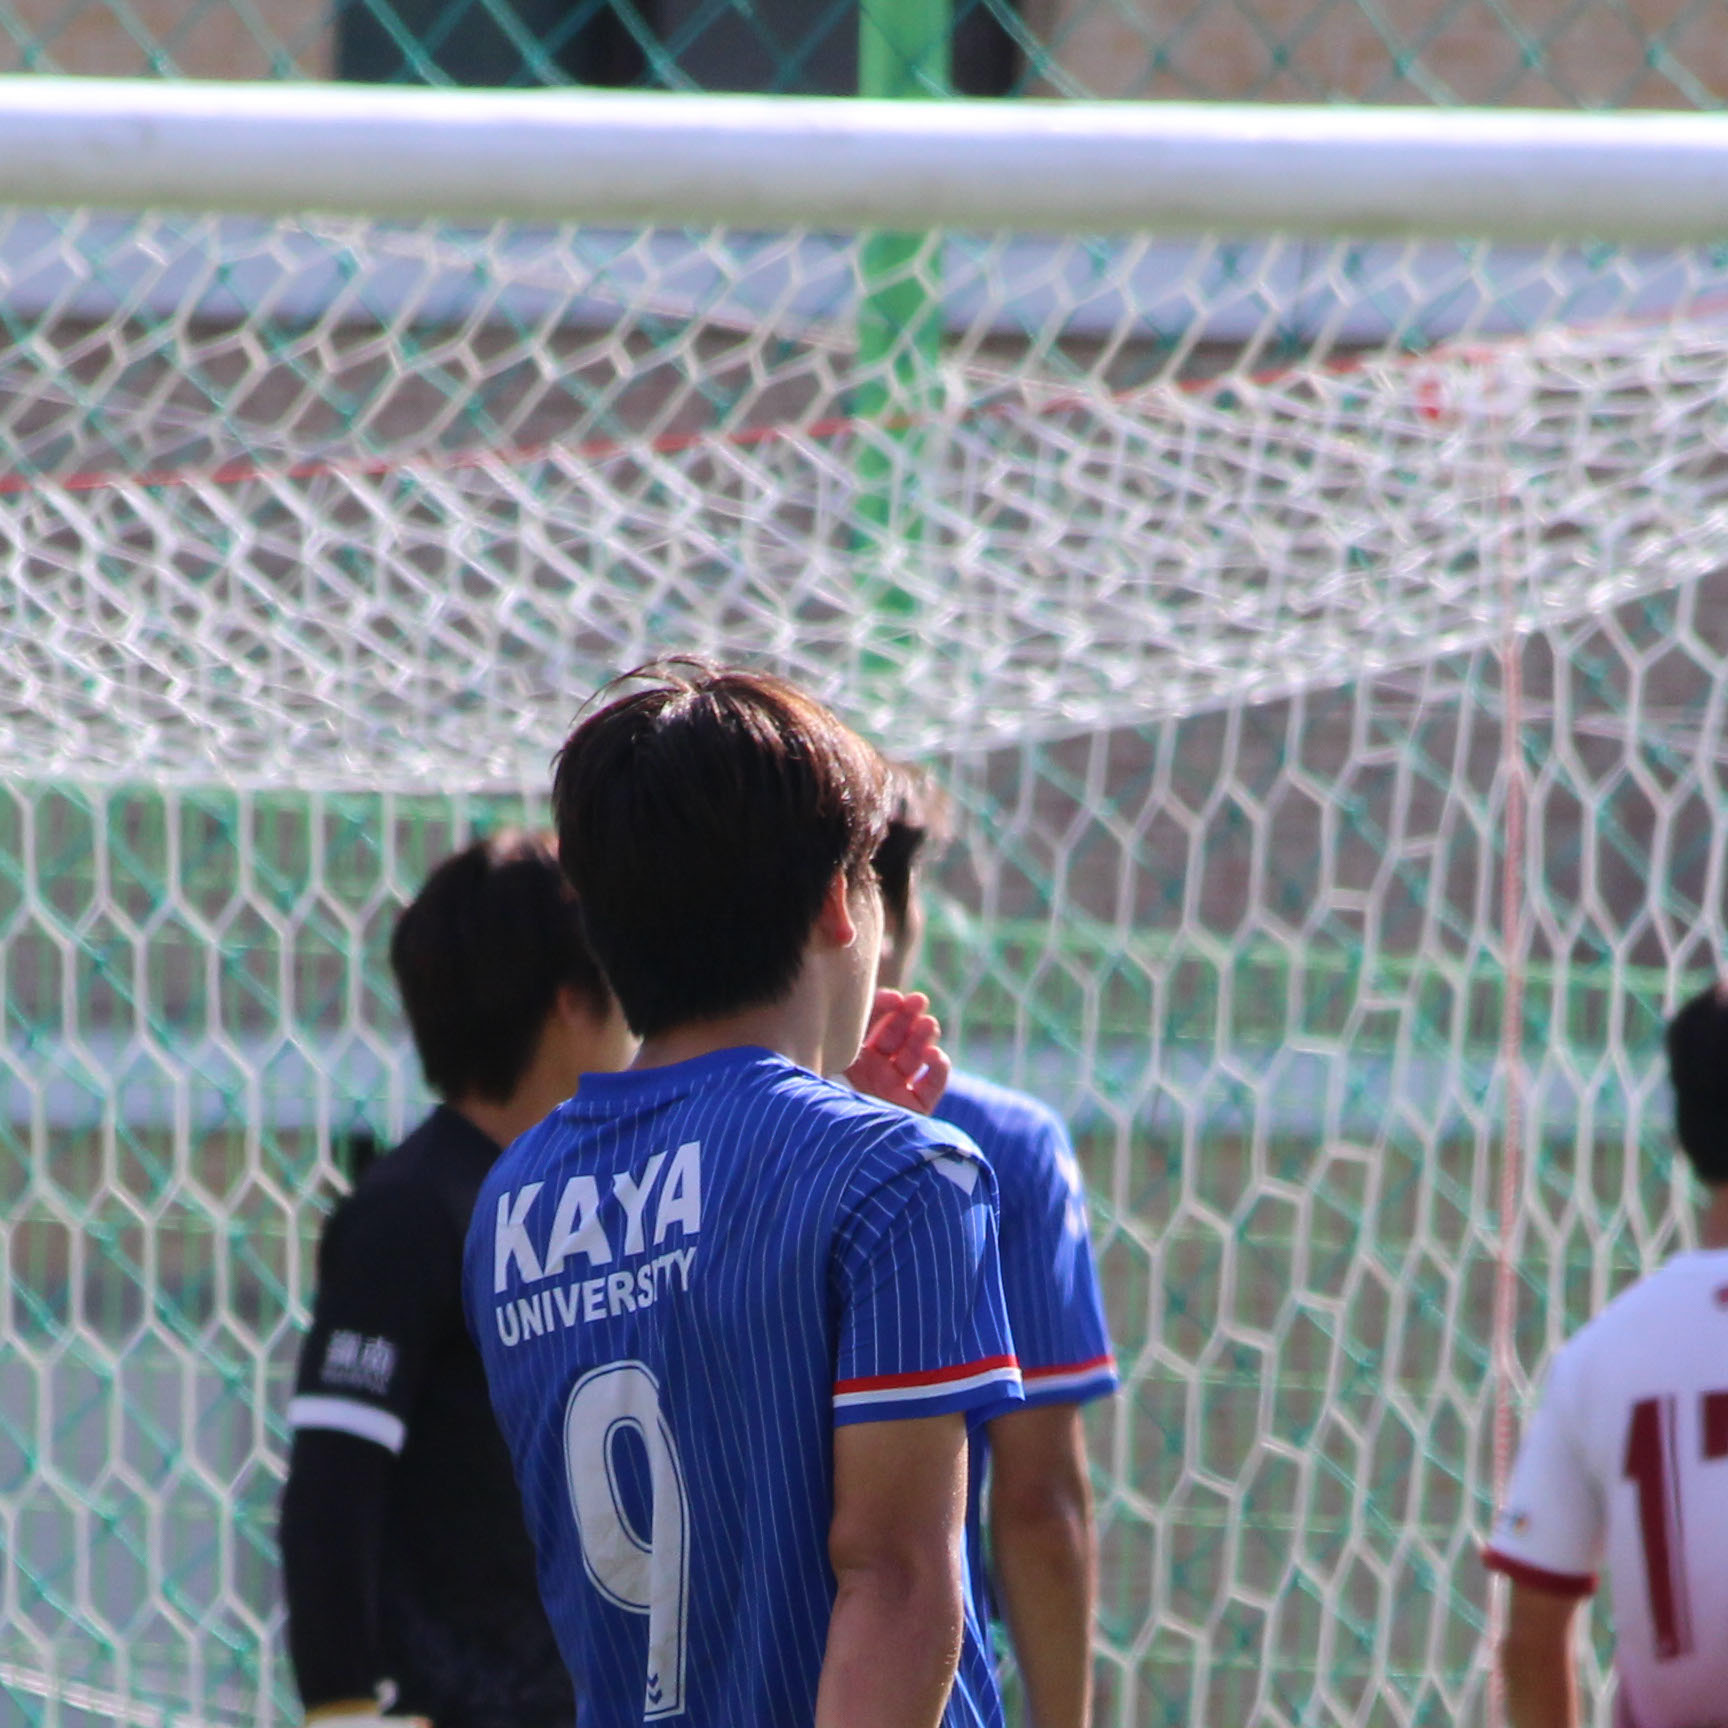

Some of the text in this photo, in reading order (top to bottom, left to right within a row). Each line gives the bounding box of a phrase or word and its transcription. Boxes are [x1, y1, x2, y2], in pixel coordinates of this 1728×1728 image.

[493, 1140, 703, 1295] KAYA
[495, 1245, 698, 1349] UNIVERSITY
[563, 1358, 692, 1724] 9
